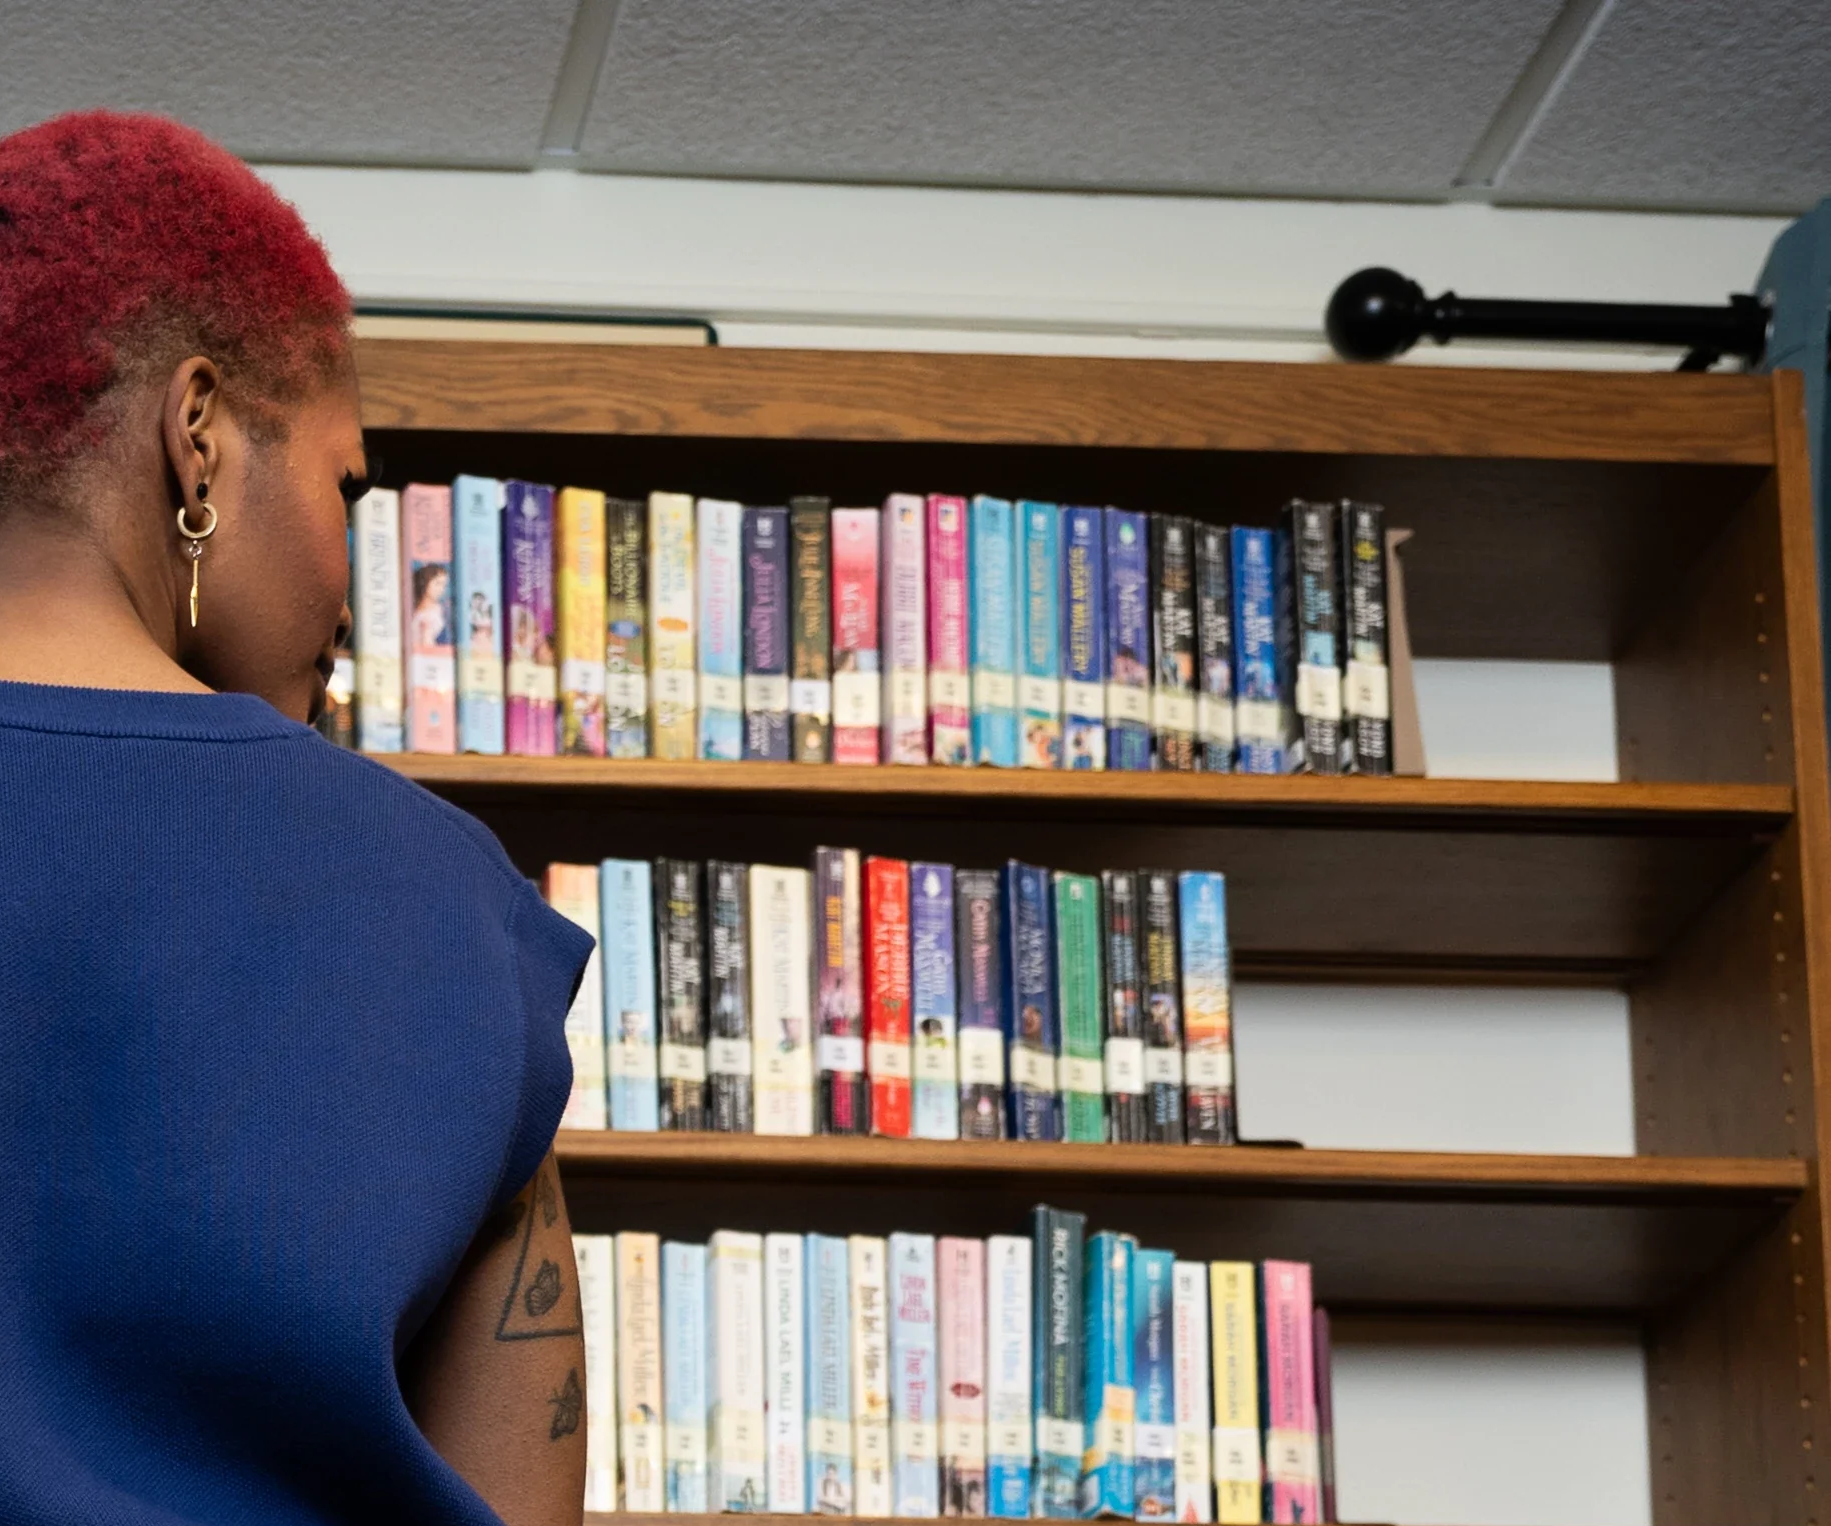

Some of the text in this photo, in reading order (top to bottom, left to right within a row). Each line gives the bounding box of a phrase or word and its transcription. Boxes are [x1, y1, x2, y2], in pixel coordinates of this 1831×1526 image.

[1070, 547, 1085, 601] SUSAN
[750, 608, 775, 668] LONDON
[1051, 1227, 1070, 1271] RICK
[778, 1280, 792, 1365] LINDA LAEL
[1051, 1273, 1070, 1346] MOFINA
